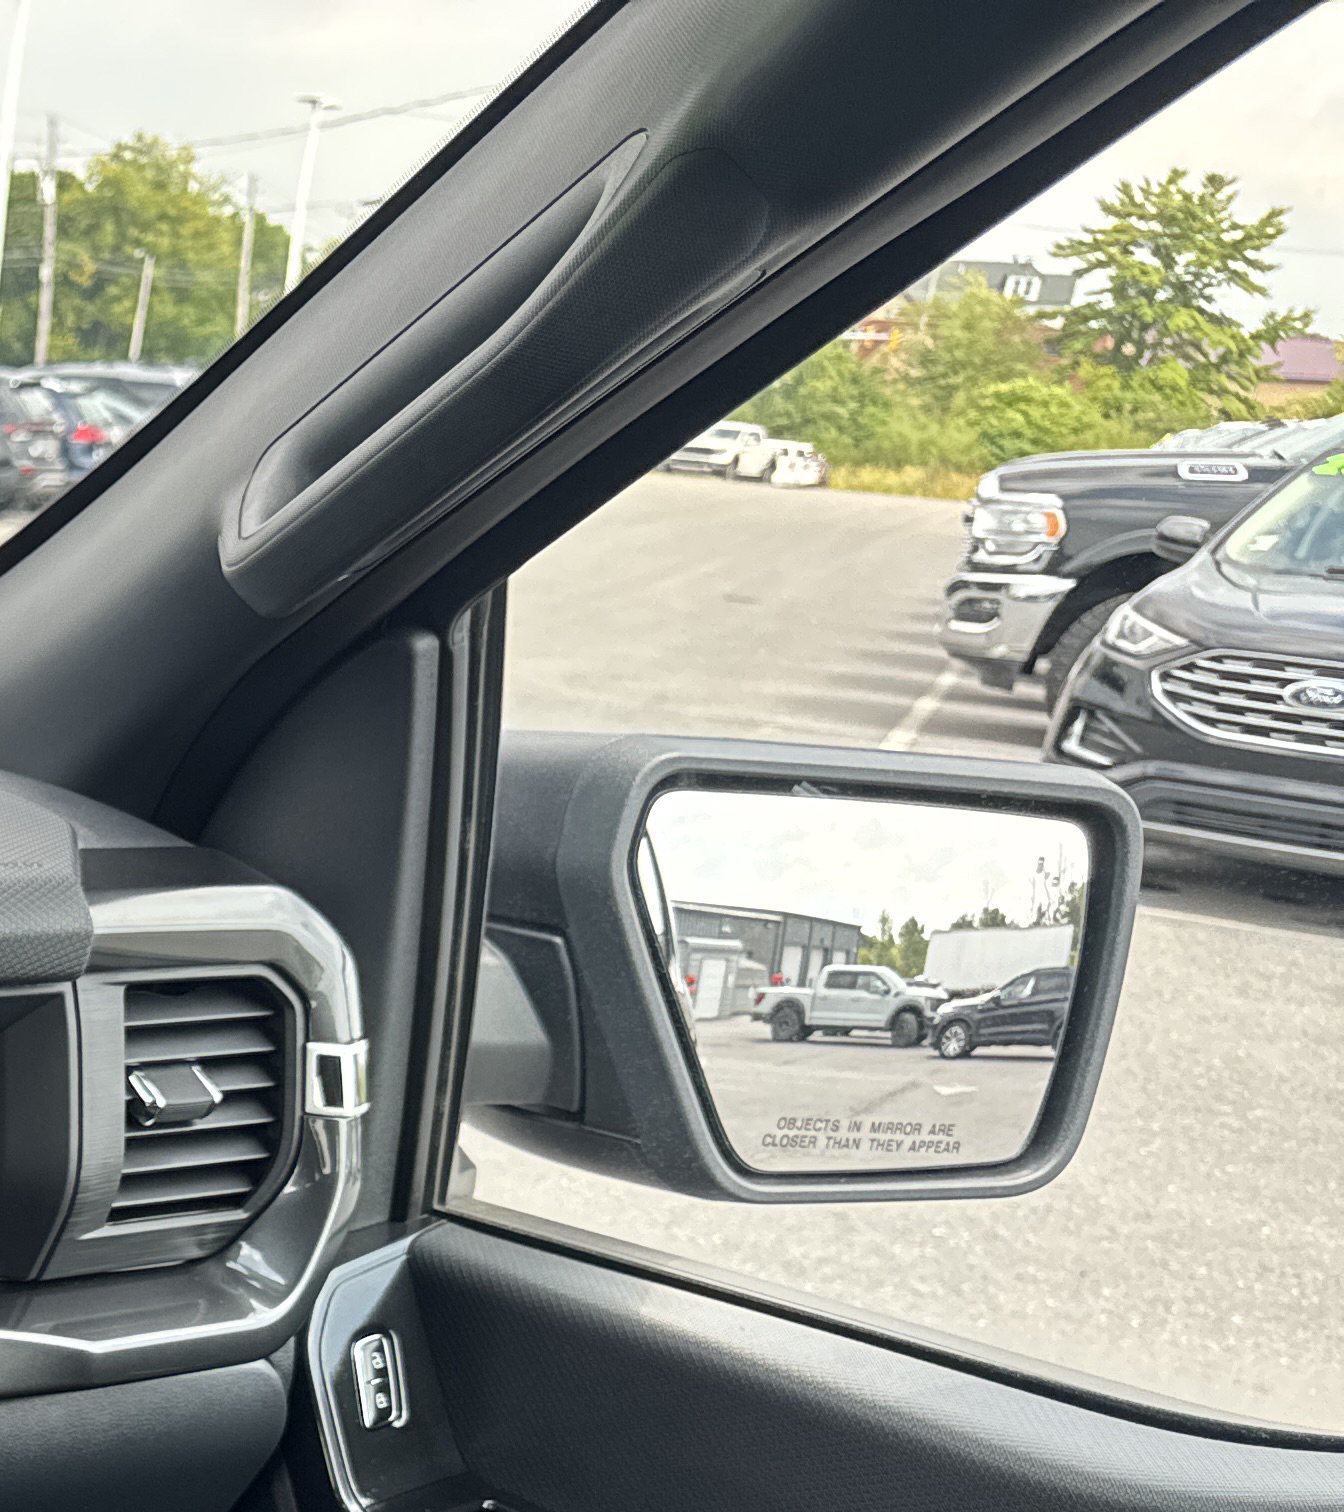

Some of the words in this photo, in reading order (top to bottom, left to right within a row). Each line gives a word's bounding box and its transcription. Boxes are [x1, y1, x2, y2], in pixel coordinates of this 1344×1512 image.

[777, 1117, 840, 1132] OBJECTS
[848, 1119, 862, 1132] IN
[869, 1120, 923, 1135] MIRROR
[928, 1122, 955, 1136] ARE
[762, 1133, 817, 1148] CLOSER
[825, 1136, 861, 1150] THAN
[869, 1138, 903, 1152] THEY
[907, 1139, 961, 1154] APPEAR
